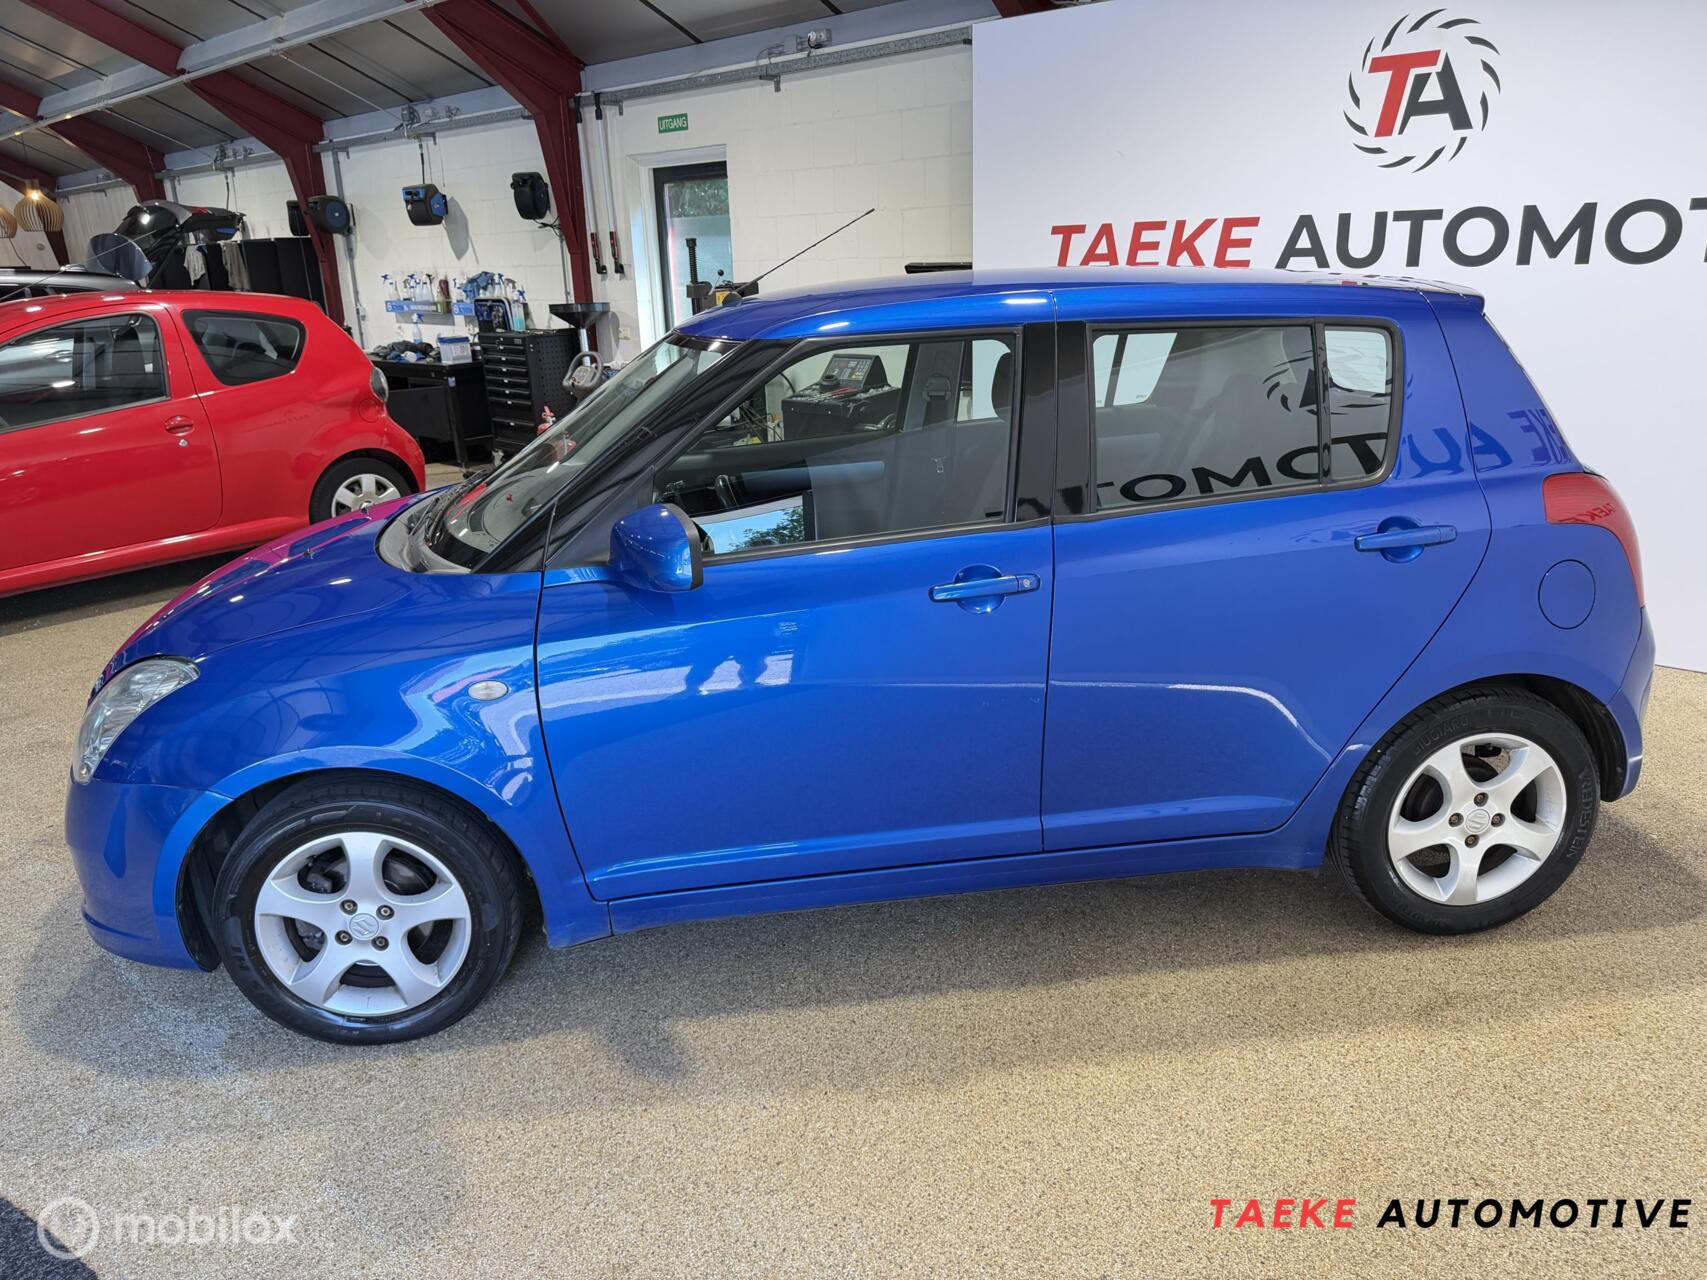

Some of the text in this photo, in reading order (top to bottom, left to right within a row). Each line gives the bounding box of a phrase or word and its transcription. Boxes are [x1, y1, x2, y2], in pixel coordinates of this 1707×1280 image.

[659, 116, 687, 130] UITGANG
[1369, 50, 1474, 138] TA
[1050, 197, 1707, 269] TAEKE AUTOMO
[1566, 766, 1594, 859] VREDESTEIN
